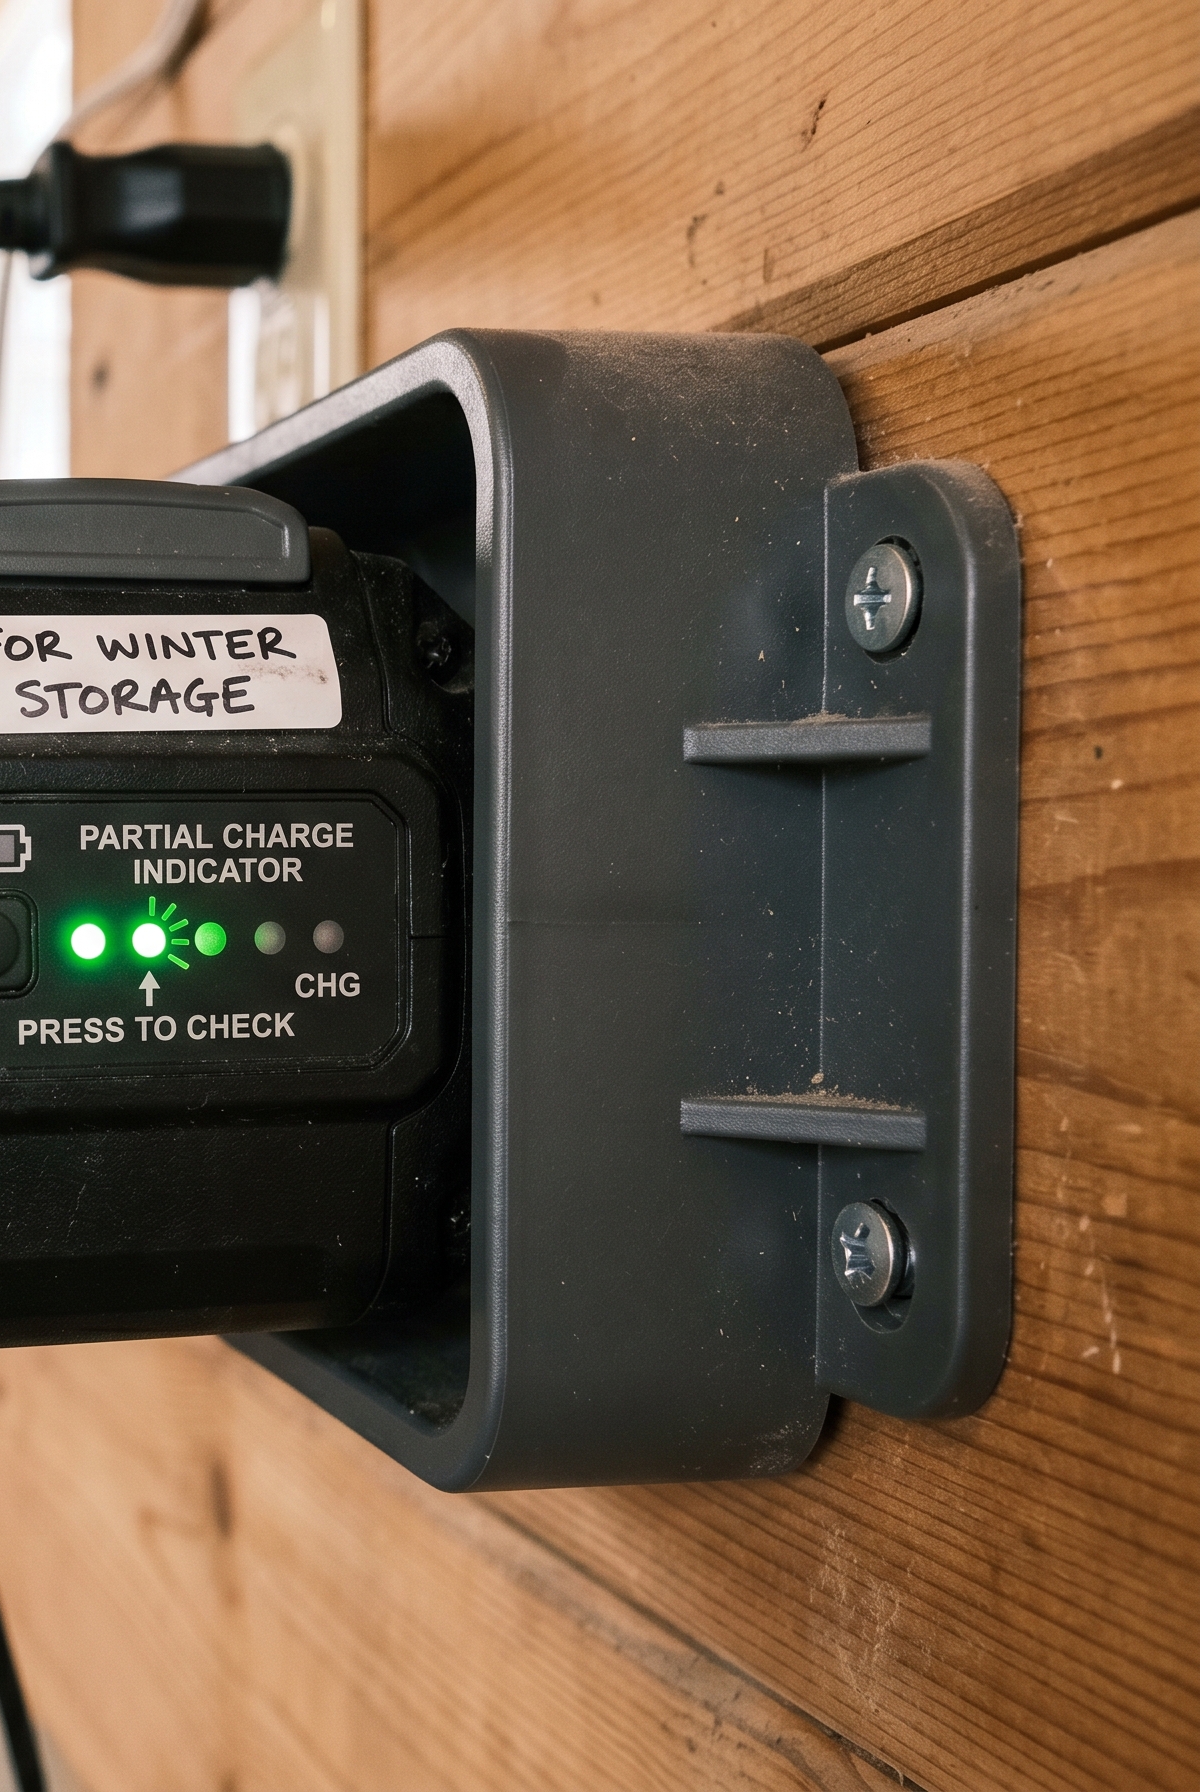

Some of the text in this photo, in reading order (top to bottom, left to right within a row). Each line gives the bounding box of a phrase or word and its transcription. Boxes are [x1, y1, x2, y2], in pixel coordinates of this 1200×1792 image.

[96, 626, 297, 662] WINTER
[13, 675, 256, 719] STORAGE
[80, 822, 355, 851] PARTIAL CHARGE
[134, 857, 304, 885] INDICATOR
[294, 972, 361, 999] CHG
[17, 1012, 296, 1046] PRESS TO CHECK
